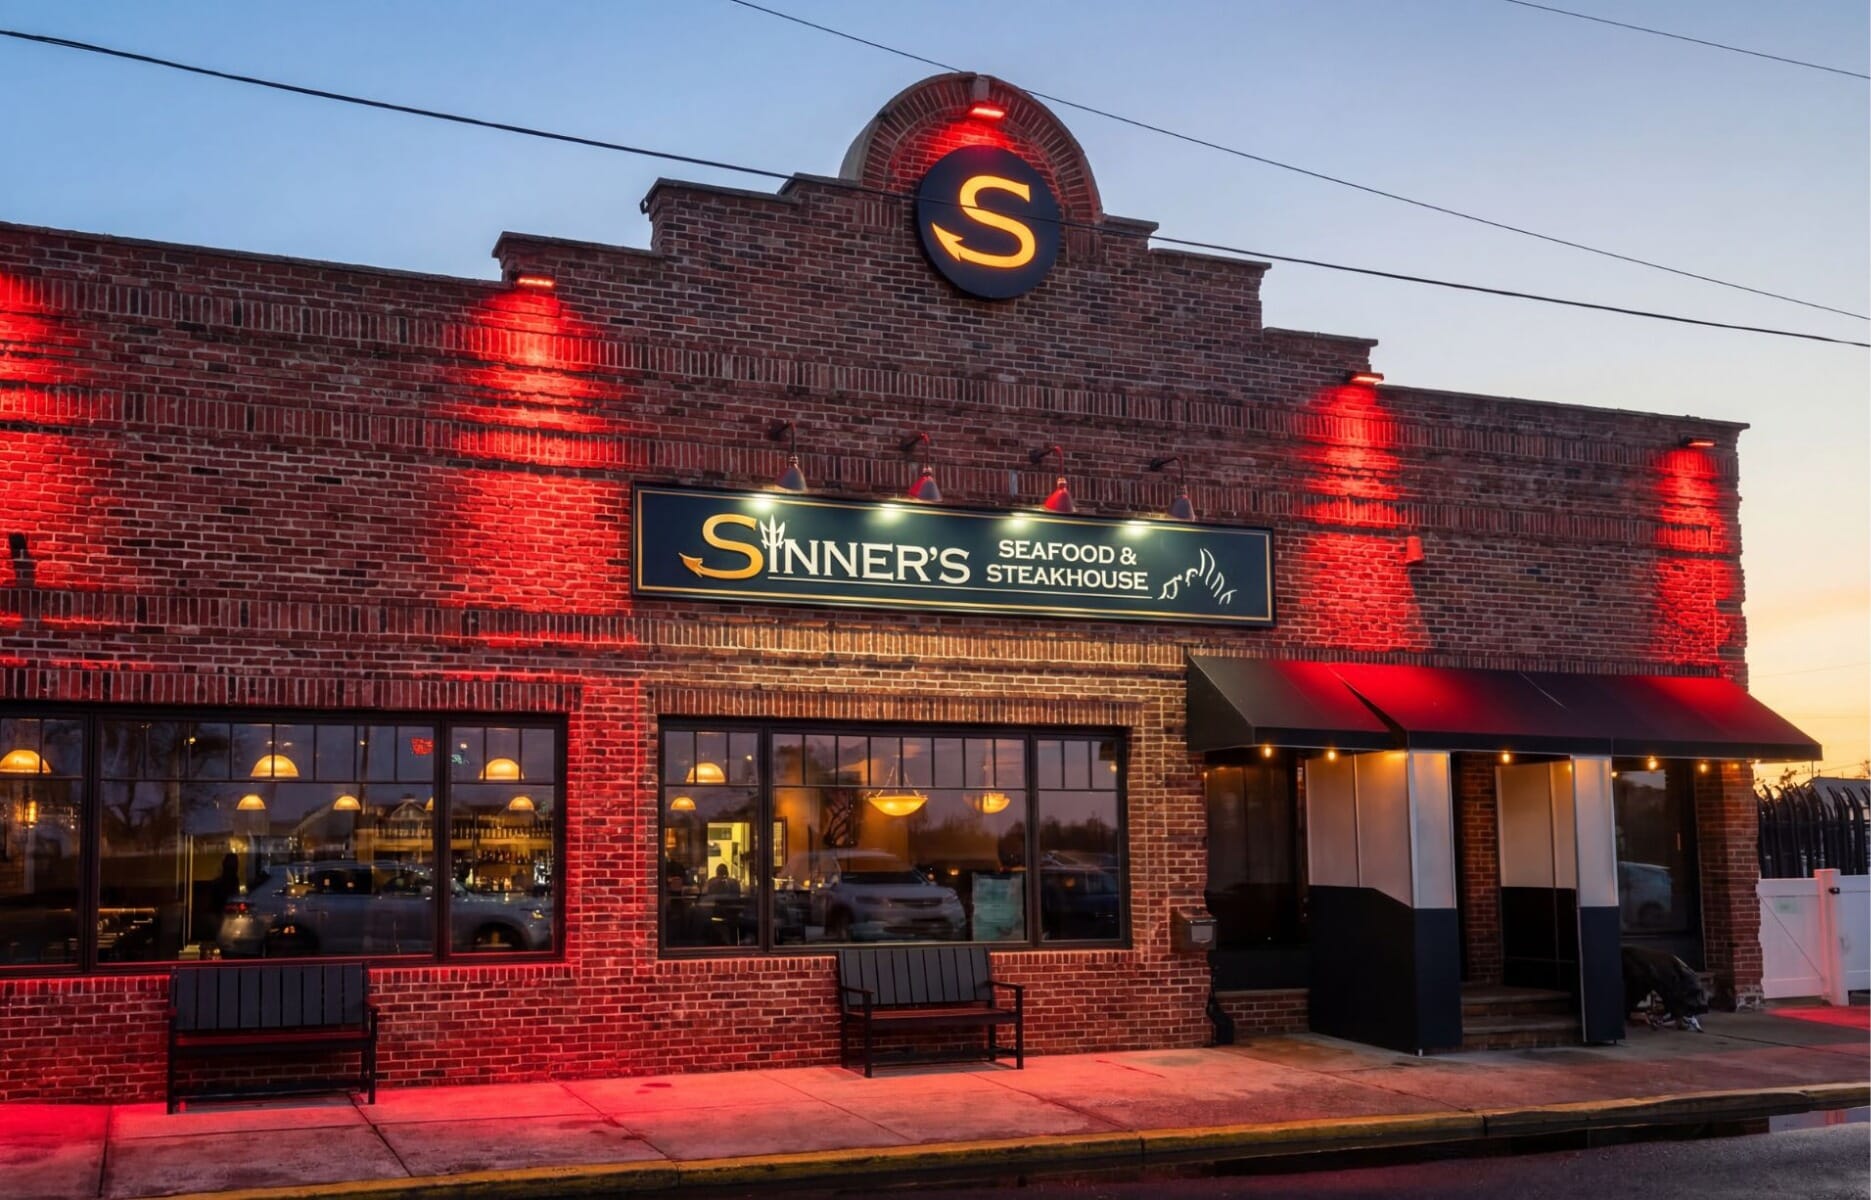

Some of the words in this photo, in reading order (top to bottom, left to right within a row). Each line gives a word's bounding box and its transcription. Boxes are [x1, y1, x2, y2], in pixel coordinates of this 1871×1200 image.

[931, 175, 1036, 268] S
[679, 513, 971, 584] SINNER'S
[998, 539, 1115, 564] SEAFOOD
[1120, 547, 1137, 566] &
[986, 563, 1149, 591] STEAKHOUSE
